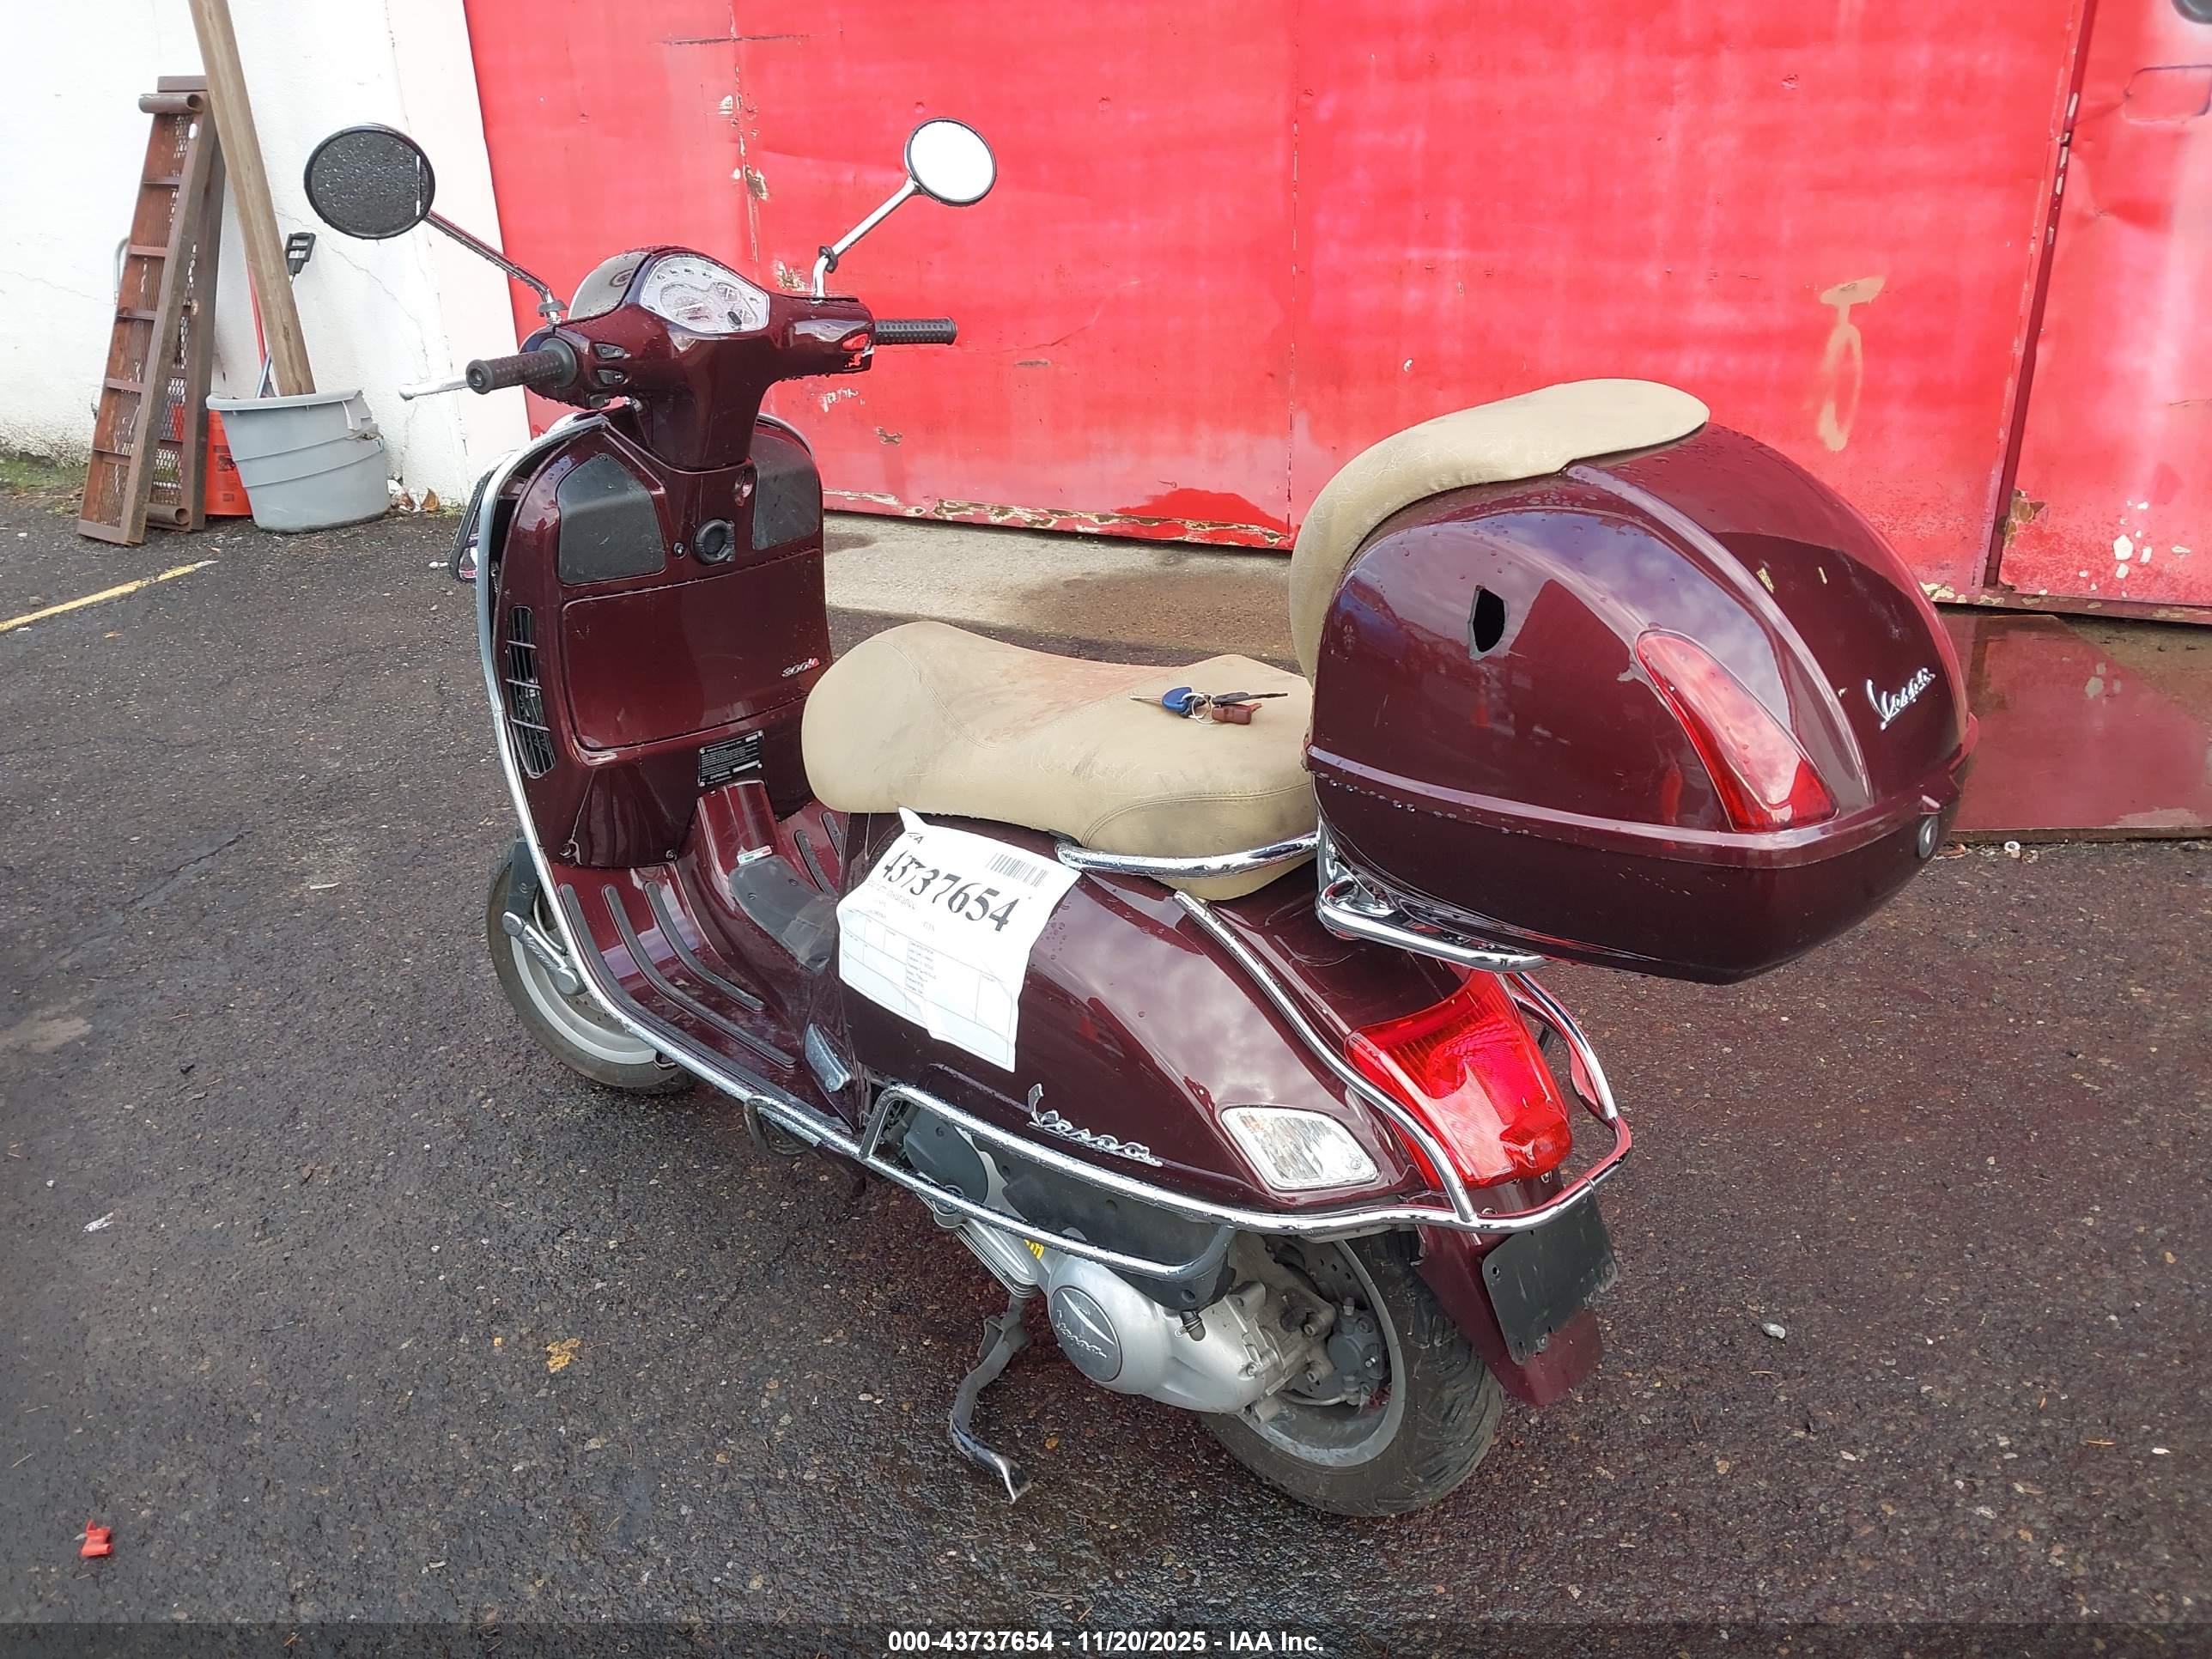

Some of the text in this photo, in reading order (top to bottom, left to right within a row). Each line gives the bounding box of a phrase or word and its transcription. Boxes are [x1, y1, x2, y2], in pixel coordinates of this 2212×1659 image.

[1866, 667, 1937, 731] Vespa
[883, 849, 1020, 933] 43737654
[1026, 1083, 1164, 1168] Vespa
